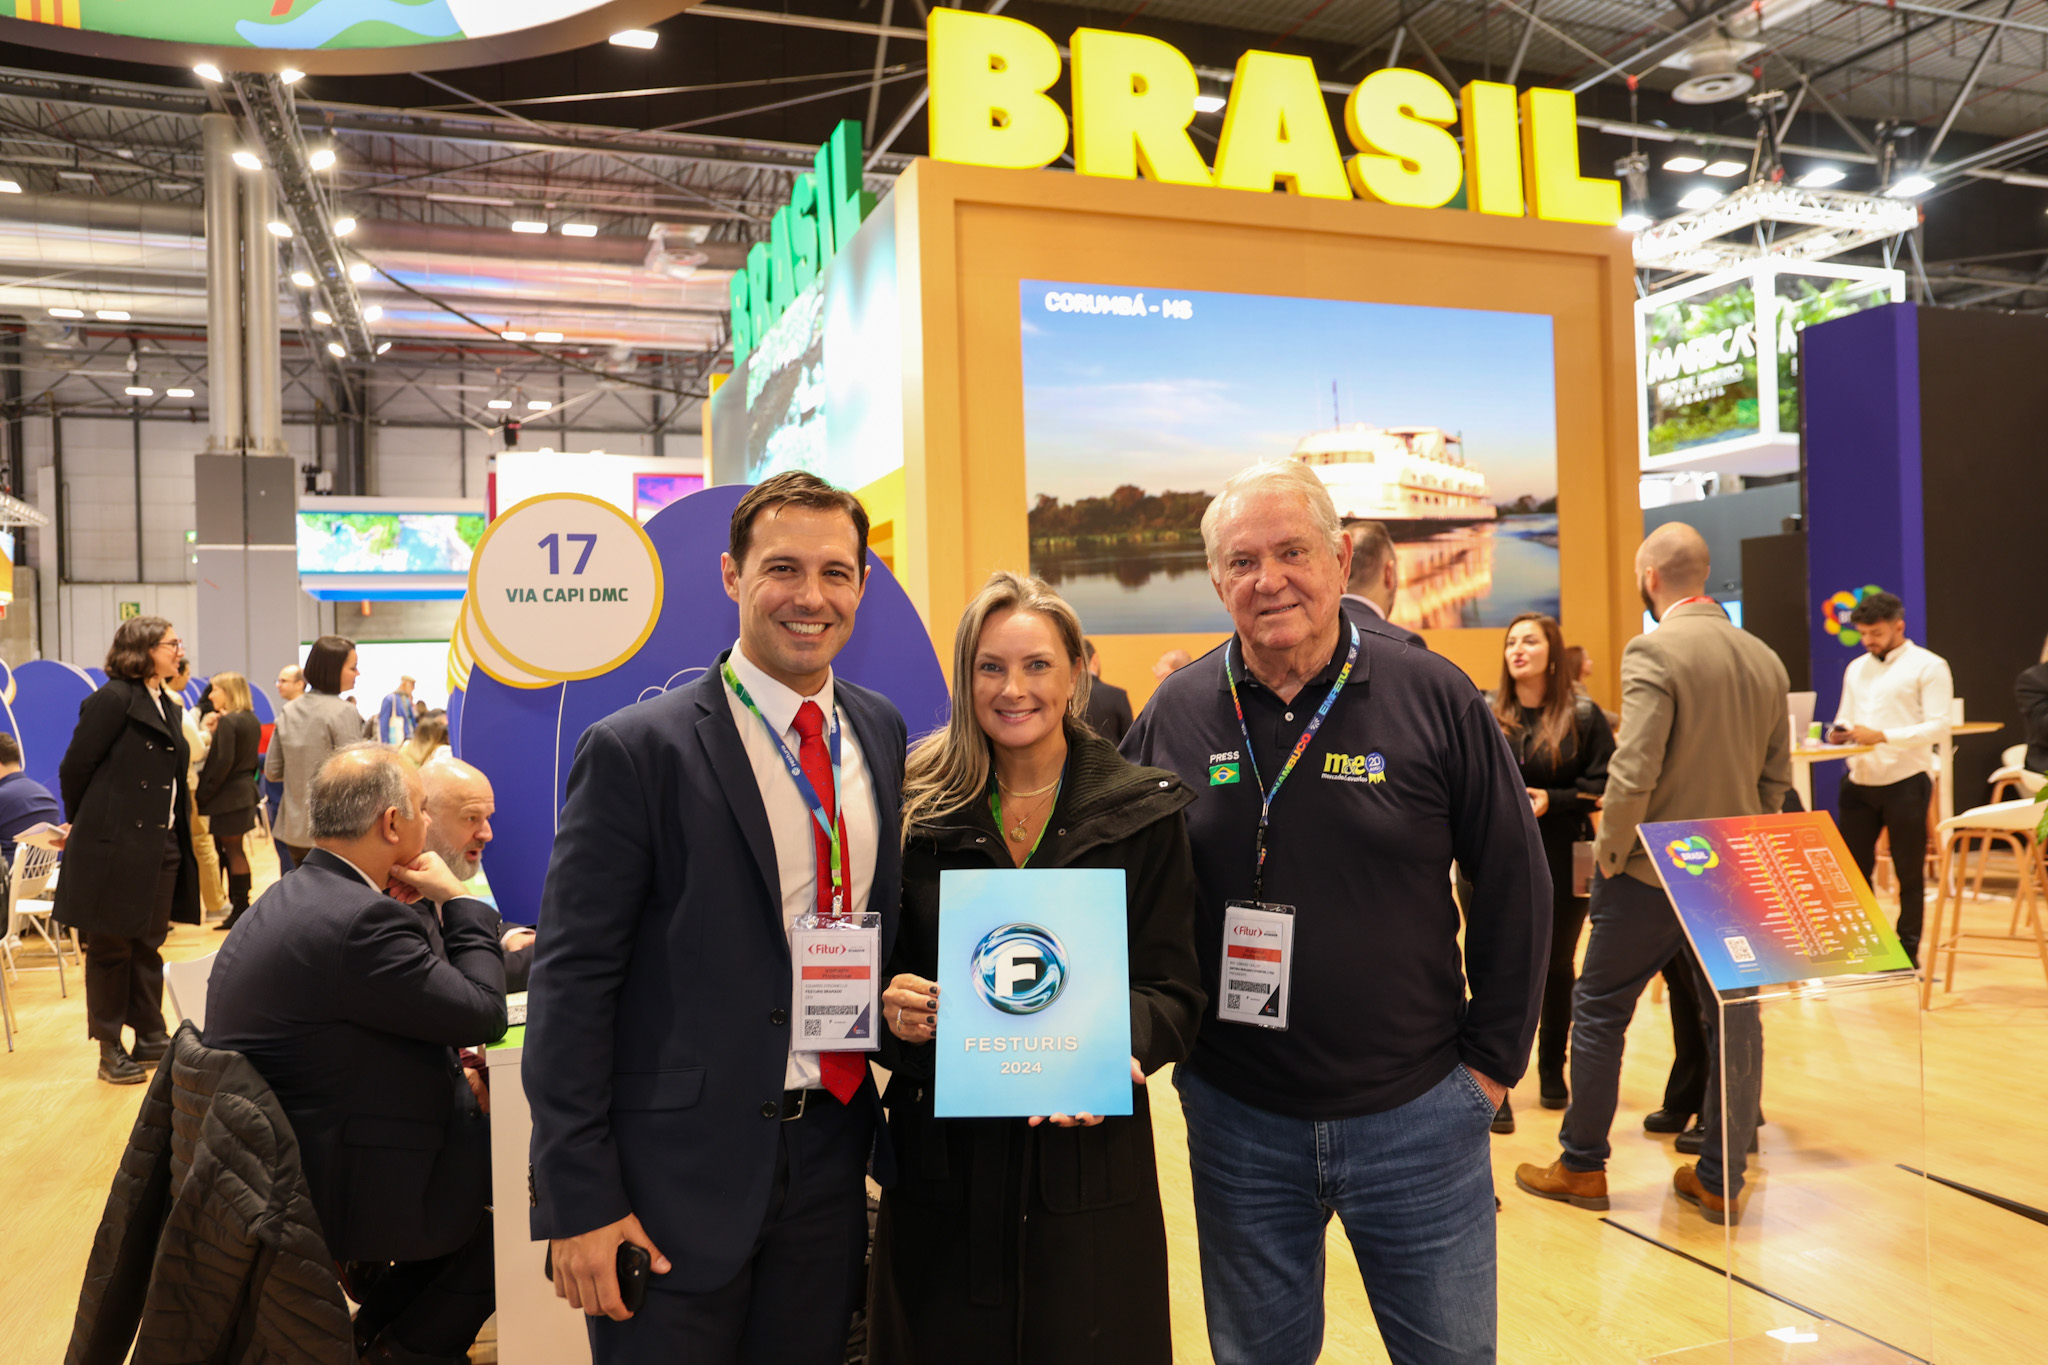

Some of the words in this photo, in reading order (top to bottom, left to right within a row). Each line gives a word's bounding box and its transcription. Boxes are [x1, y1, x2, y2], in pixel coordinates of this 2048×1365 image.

[927, 6, 1622, 227] BRASIL
[730, 119, 877, 370] BRASIL
[1045, 291, 1147, 317] CORUMBÁ
[1162, 298, 1193, 320] MS
[538, 533, 597, 575] 17
[505, 588, 538, 603] VIA
[543, 588, 584, 602] CAPI
[589, 588, 628, 602] DMC
[1318, 661, 1353, 716] EMPETUR
[1209, 751, 1240, 764] PRESS
[1323, 752, 1366, 776] m&e
[1368, 756, 1381, 767] 20
[1680, 851, 1709, 861] BRASIL
[1239, 925, 1258, 936] Fitur
[815, 943, 840, 955] Fitur
[965, 1036, 1078, 1051] FESTURIS
[1001, 1061, 1042, 1074] 2024
